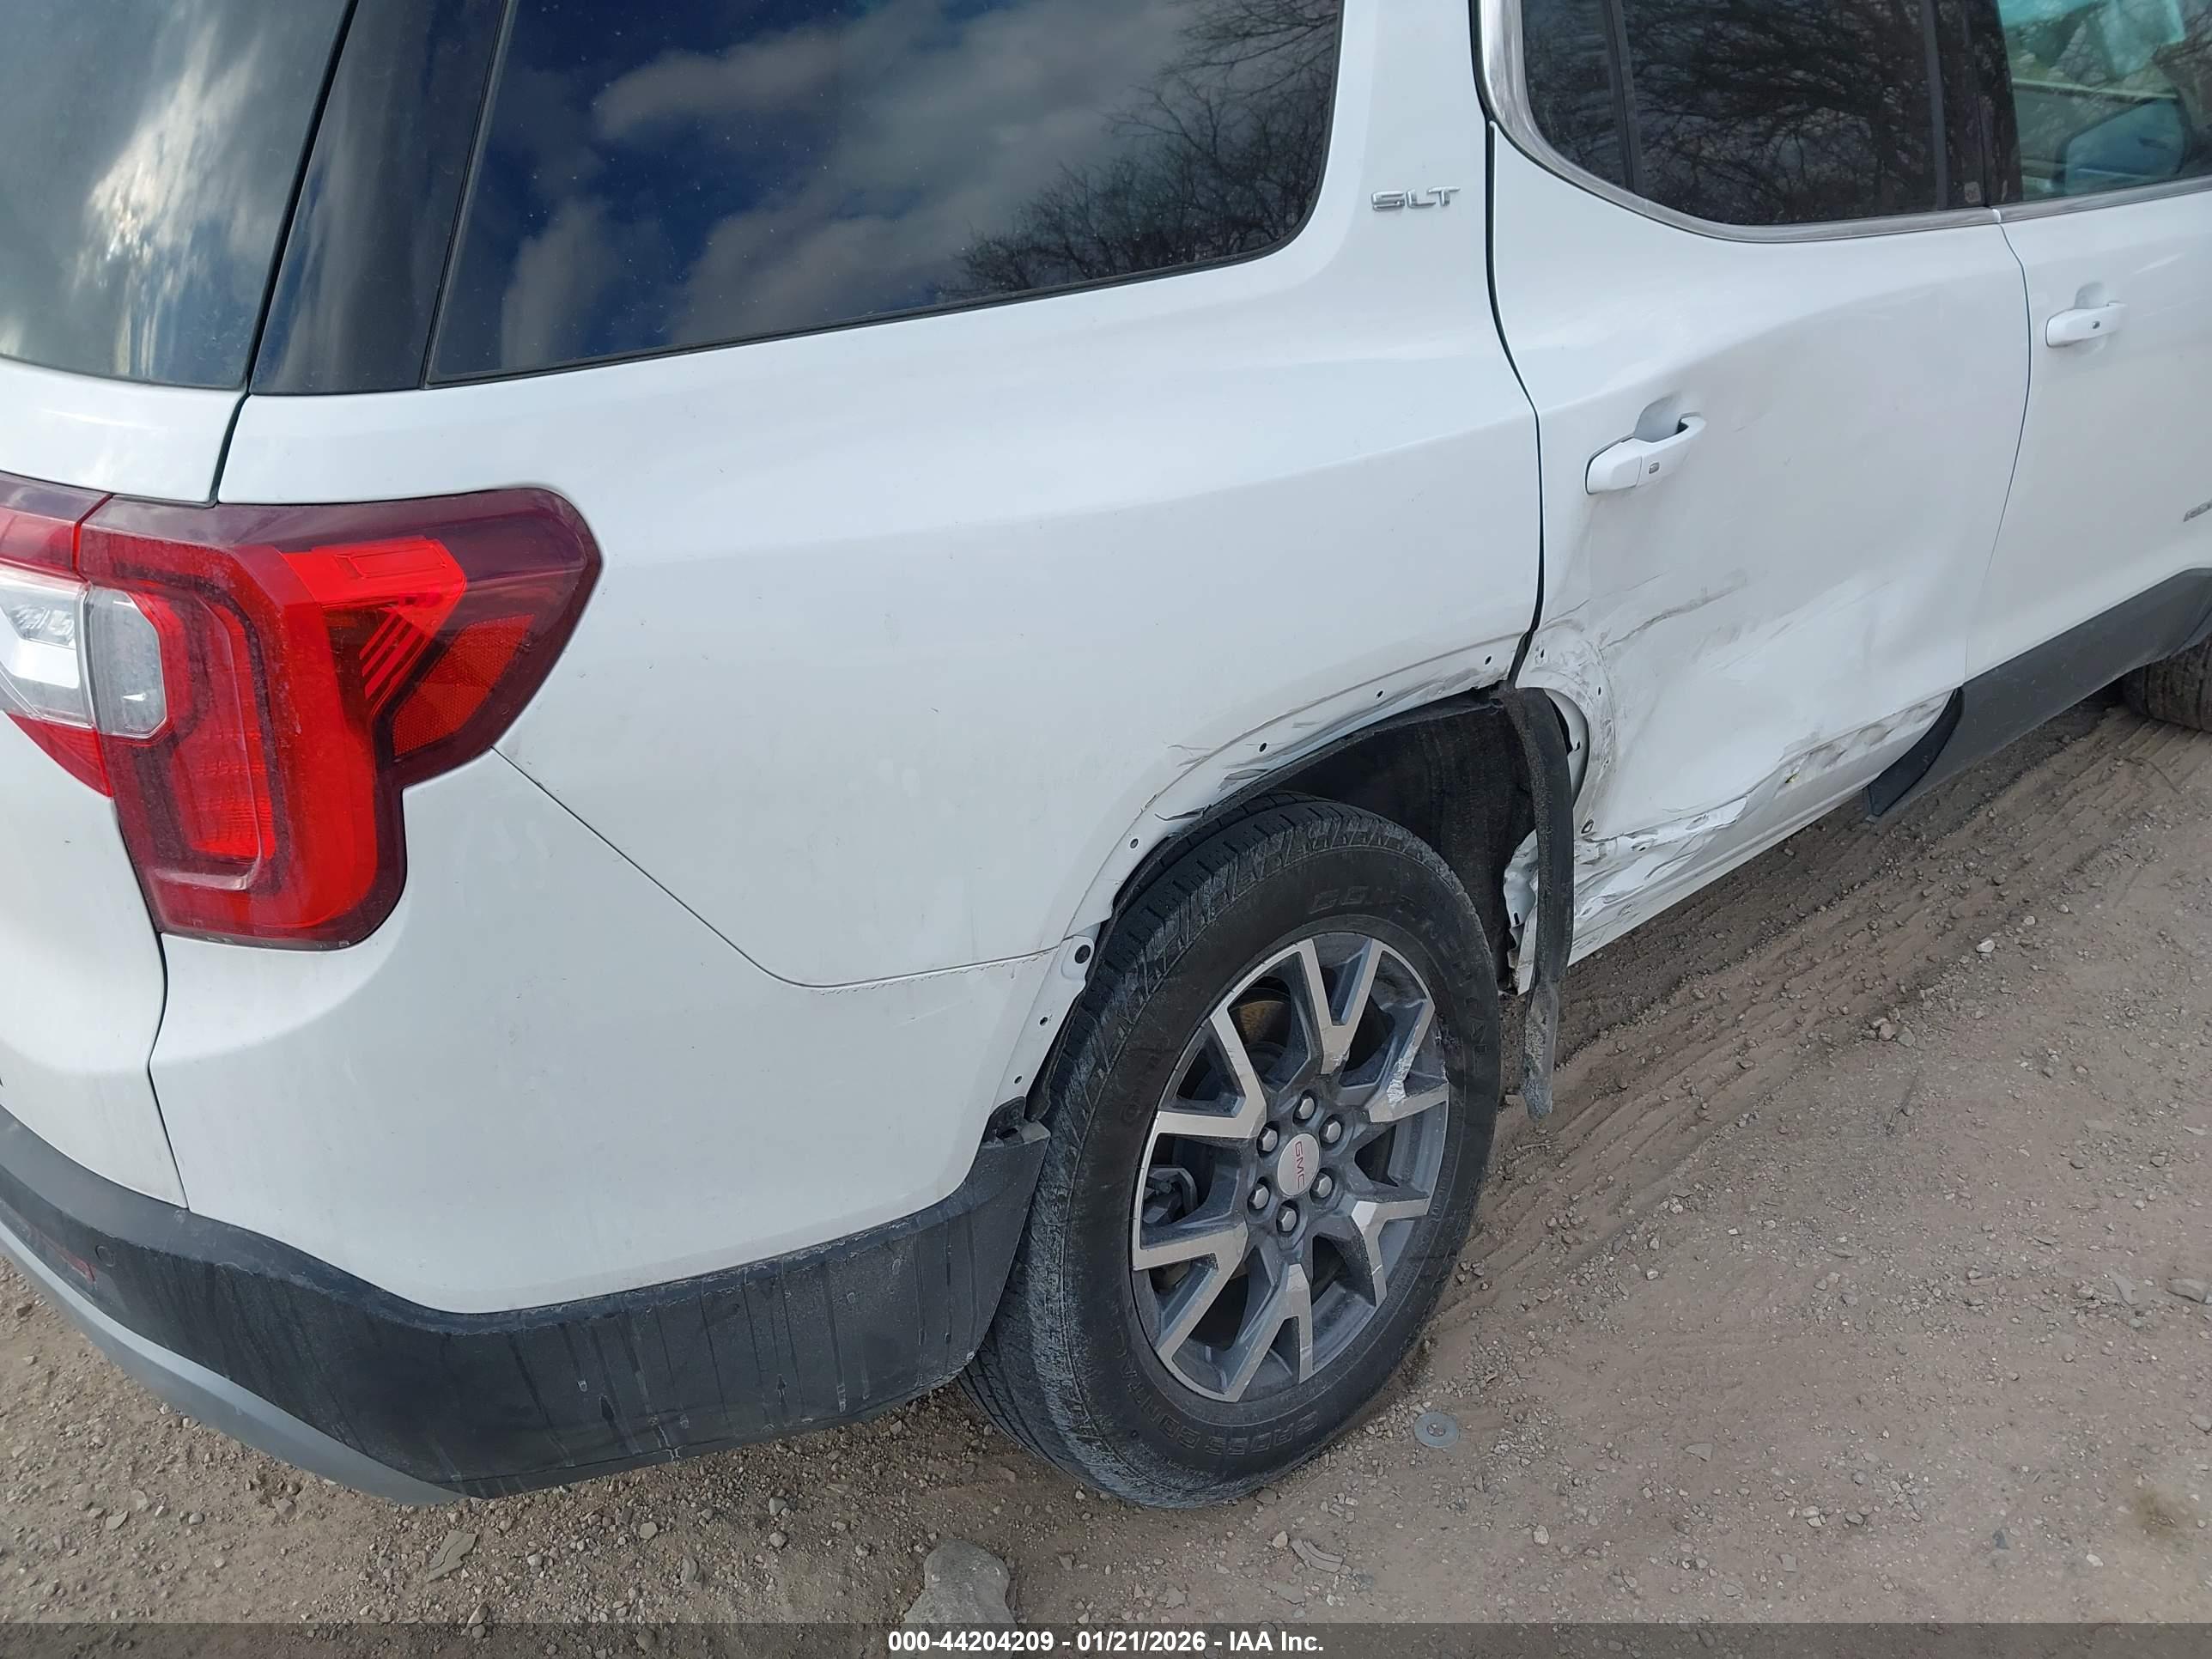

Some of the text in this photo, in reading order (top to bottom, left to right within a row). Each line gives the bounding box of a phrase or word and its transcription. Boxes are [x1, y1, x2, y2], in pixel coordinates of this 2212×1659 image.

[1371, 185, 1462, 211] SLT
[1294, 1140, 1305, 1190] GMC
[1202, 1410, 1319, 1456] CROSS
